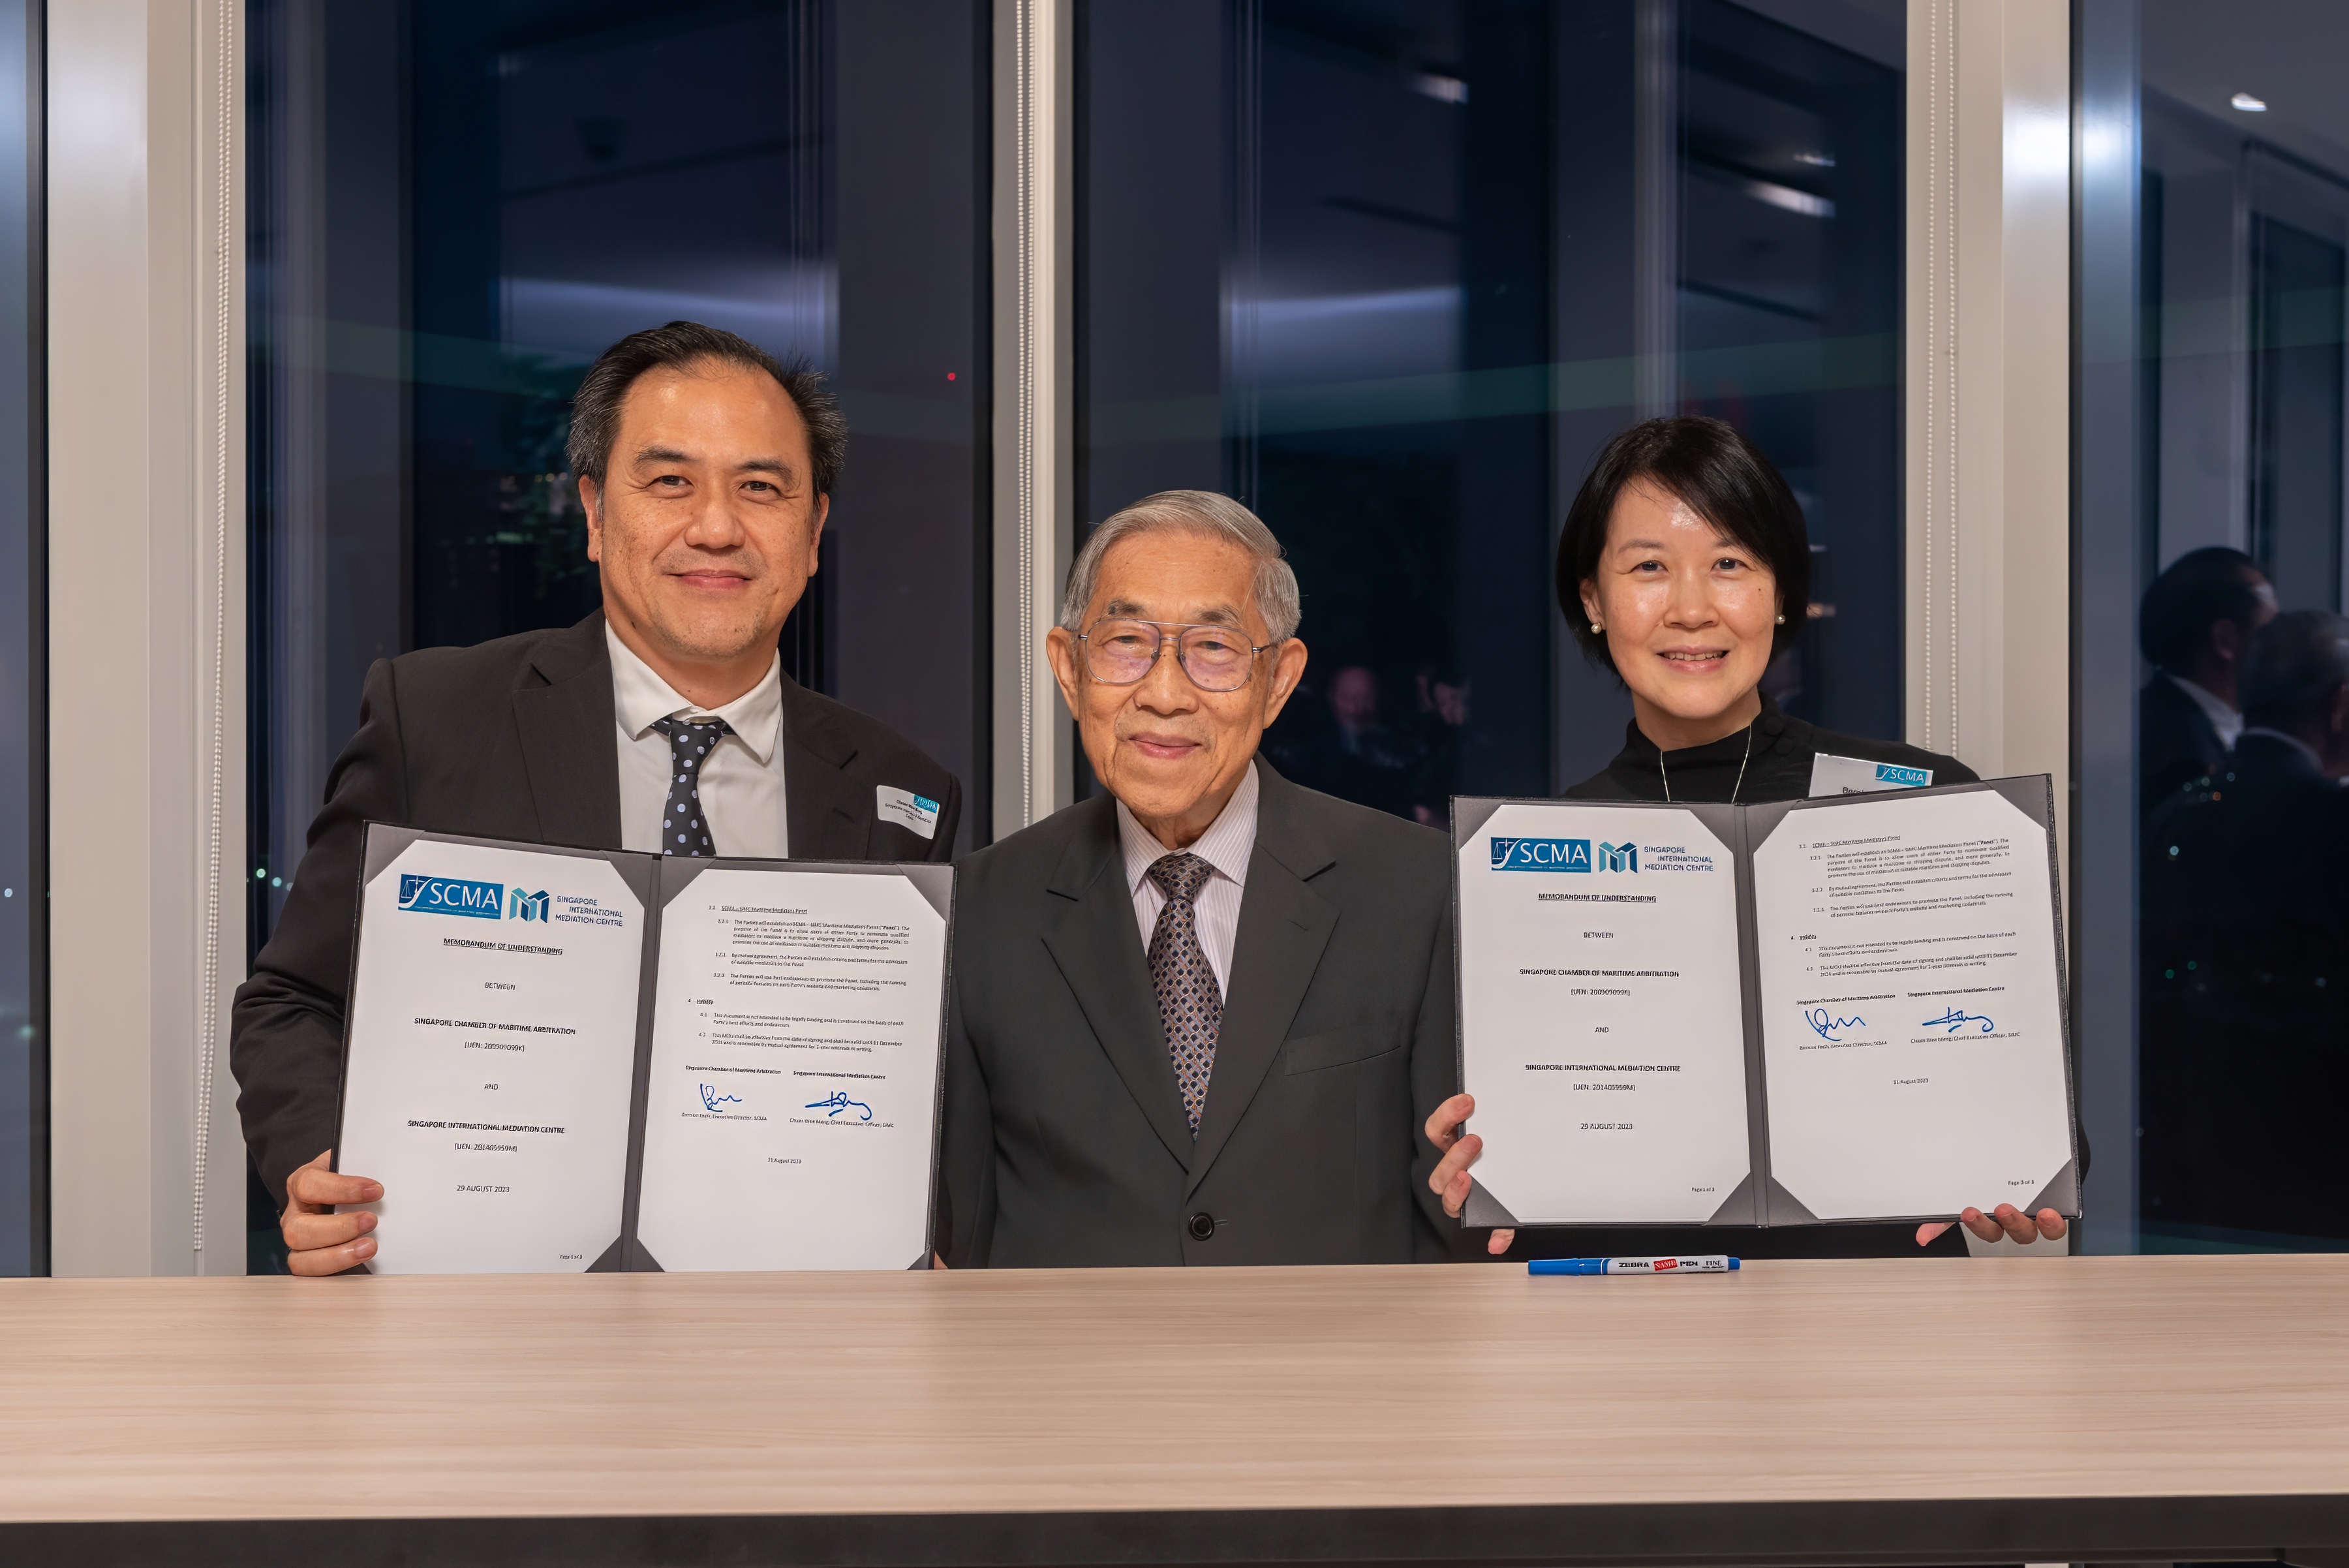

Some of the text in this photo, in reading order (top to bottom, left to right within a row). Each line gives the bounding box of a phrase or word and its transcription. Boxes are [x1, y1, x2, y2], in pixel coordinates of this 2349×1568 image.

[1891, 768, 1924, 783] SCMA
[1520, 842, 1588, 865] SCMA
[1657, 855, 1713, 863] INTERNATIONAL
[429, 882, 499, 910] SCMA
[557, 895, 598, 906] SINGAPORE
[1538, 893, 1591, 902] MEMORANDUM
[1601, 894, 1657, 903] UNDERSTANDING
[568, 906, 623, 918] INTERNATIONAL
[555, 914, 622, 927] MEDIATION CENTRE
[443, 938, 497, 951] MEMORANDUM
[506, 944, 563, 956] UNDERSTANDING
[484, 981, 515, 991] BETWEEN
[414, 1017, 453, 1027] SINGAPORE
[454, 1021, 487, 1029] CHAMBER
[498, 1023, 532, 1032] MARITIME
[532, 1026, 576, 1035] ARBITRATION
[407, 1120, 447, 1129] SINGAPORE
[448, 1122, 502, 1131] INTERNATIONAL
[502, 1124, 540, 1133] MEDIATION
